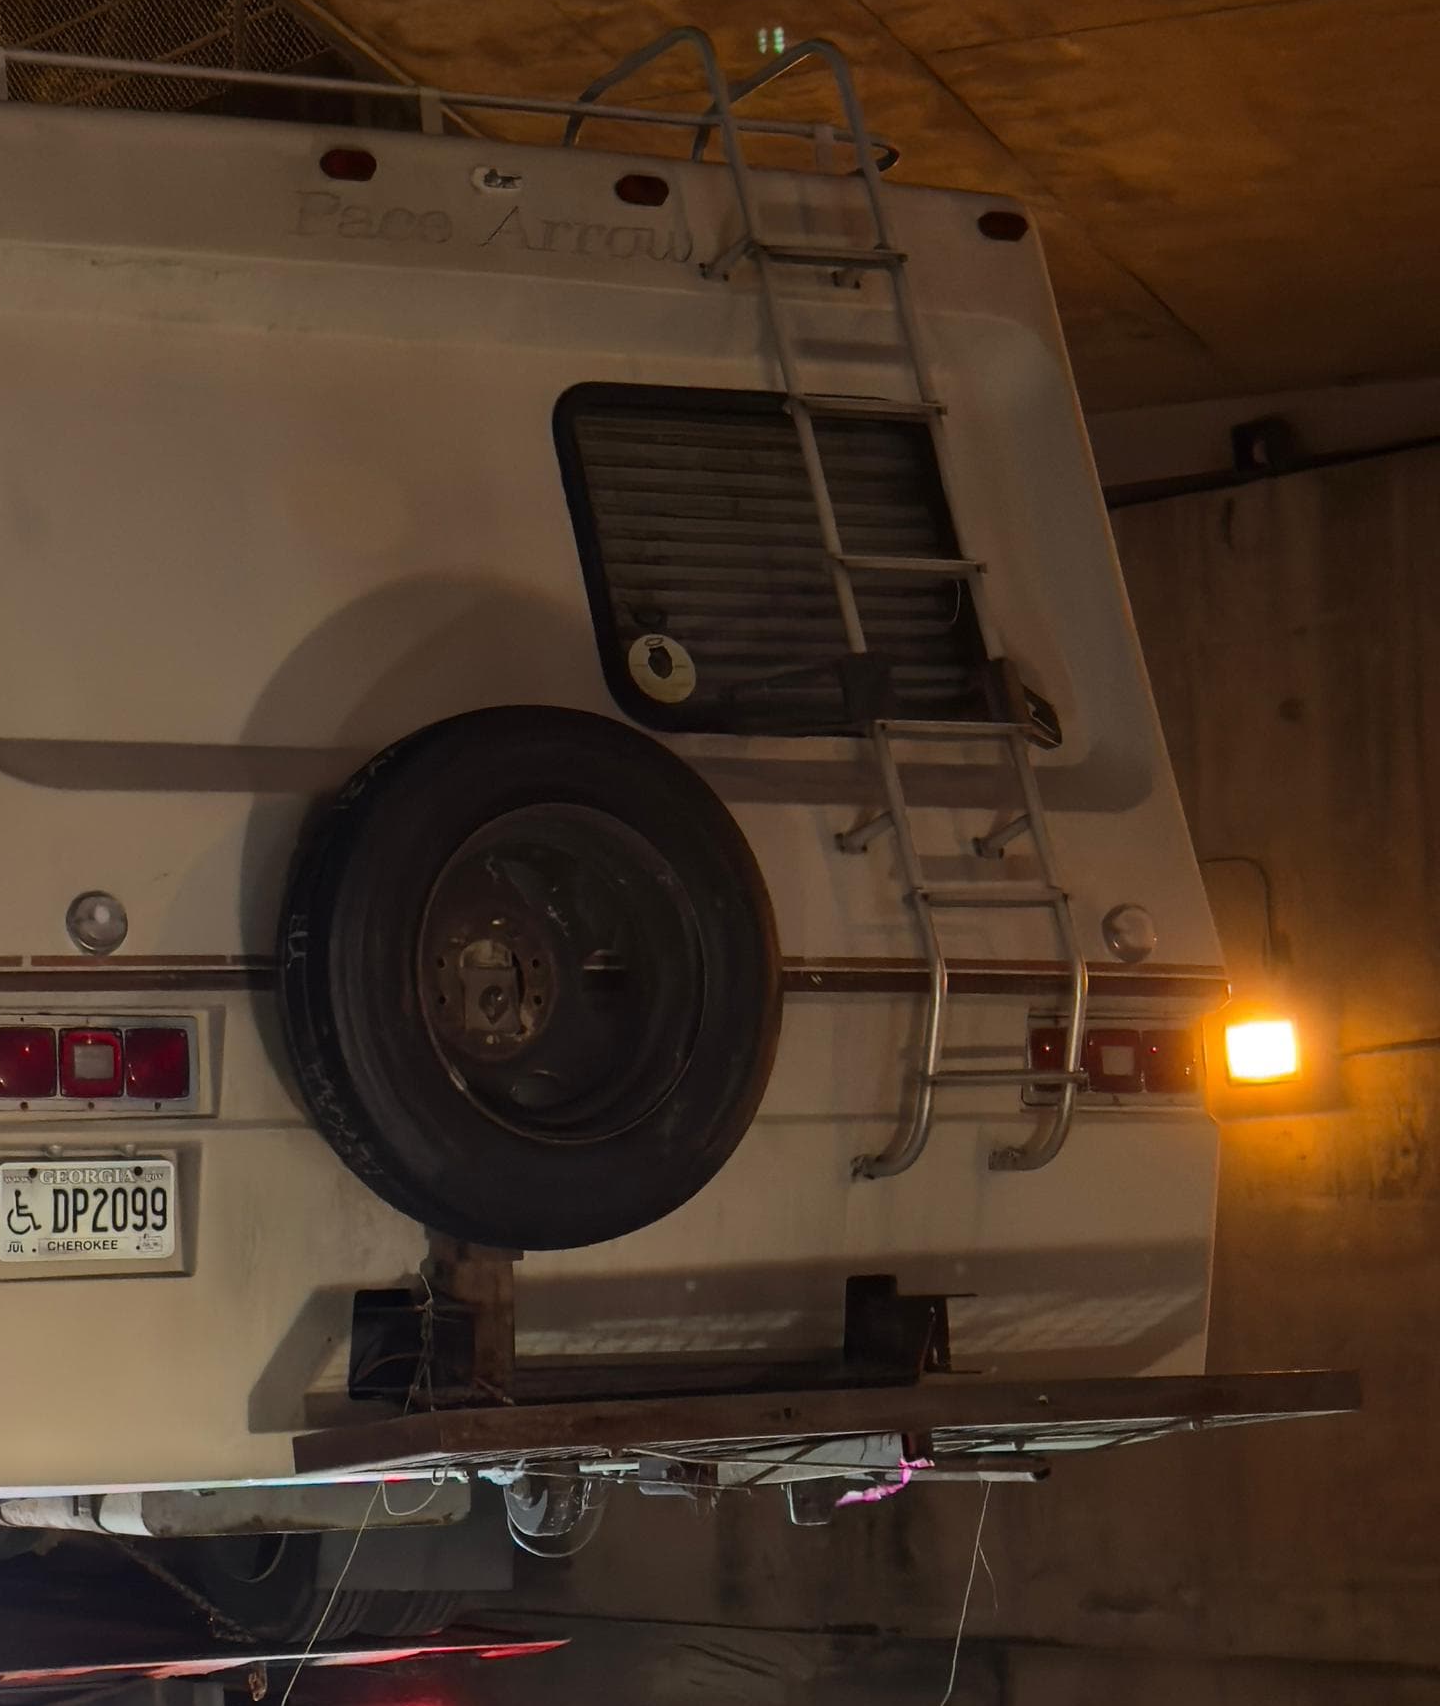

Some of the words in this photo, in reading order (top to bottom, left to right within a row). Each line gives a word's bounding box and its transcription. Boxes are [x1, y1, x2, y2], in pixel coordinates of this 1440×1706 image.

[39, 1168, 136, 1185] GEORGIA
[52, 1186, 168, 1233] DP2099
[47, 1239, 119, 1252] CHEROKEE
